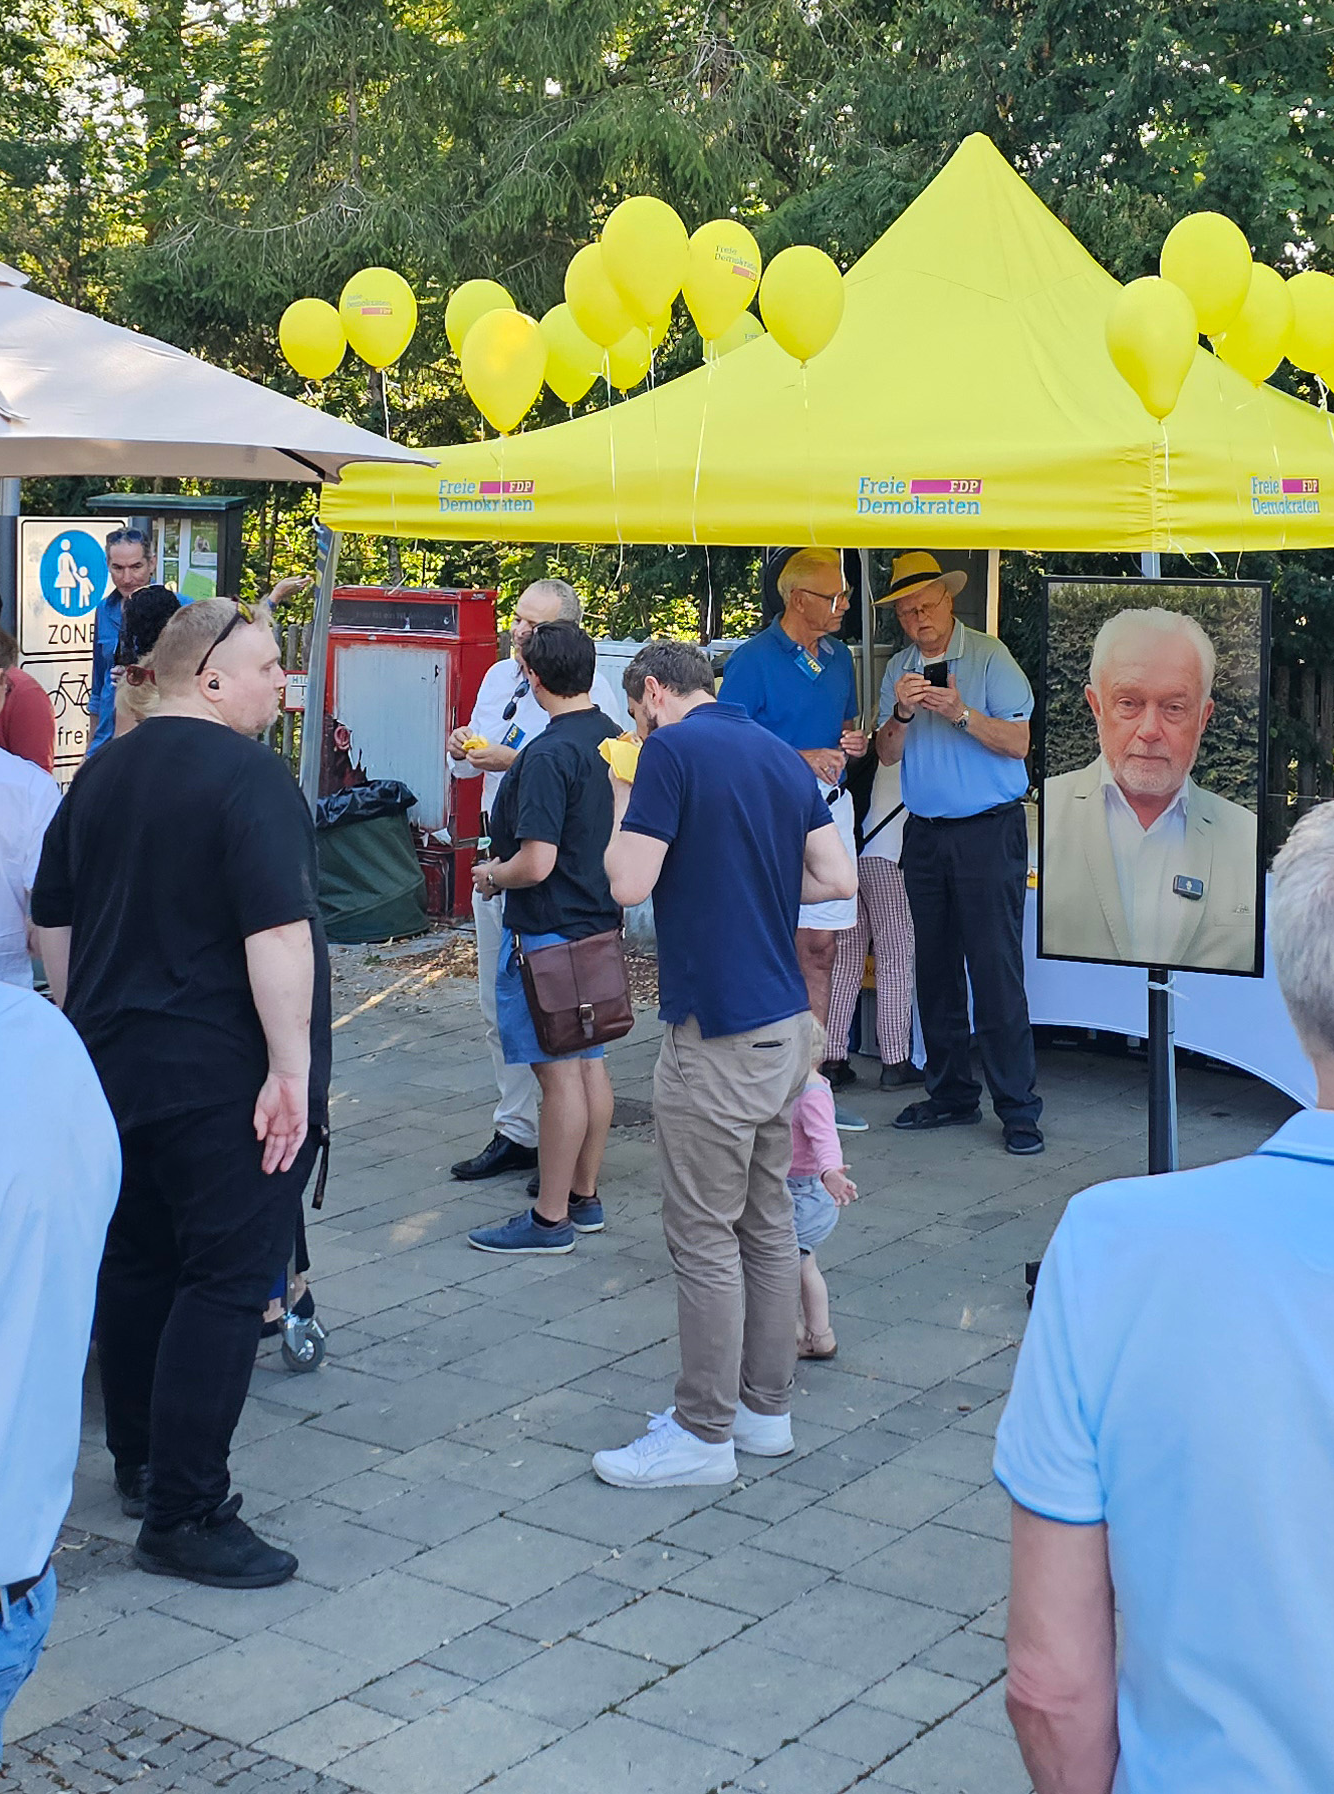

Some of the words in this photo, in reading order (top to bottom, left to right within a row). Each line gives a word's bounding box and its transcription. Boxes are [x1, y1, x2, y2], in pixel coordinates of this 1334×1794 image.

[439, 478, 476, 494] Freie
[509, 481, 532, 493] FDP
[859, 476, 906, 494] Freie
[949, 480, 979, 493] FDP
[1251, 476, 1279, 494] Freie
[1302, 480, 1318, 492] FDP
[439, 496, 534, 512] Demokraten
[857, 496, 981, 514] Demokraten
[1252, 496, 1320, 514] Demokraten
[58, 724, 91, 747] frei
